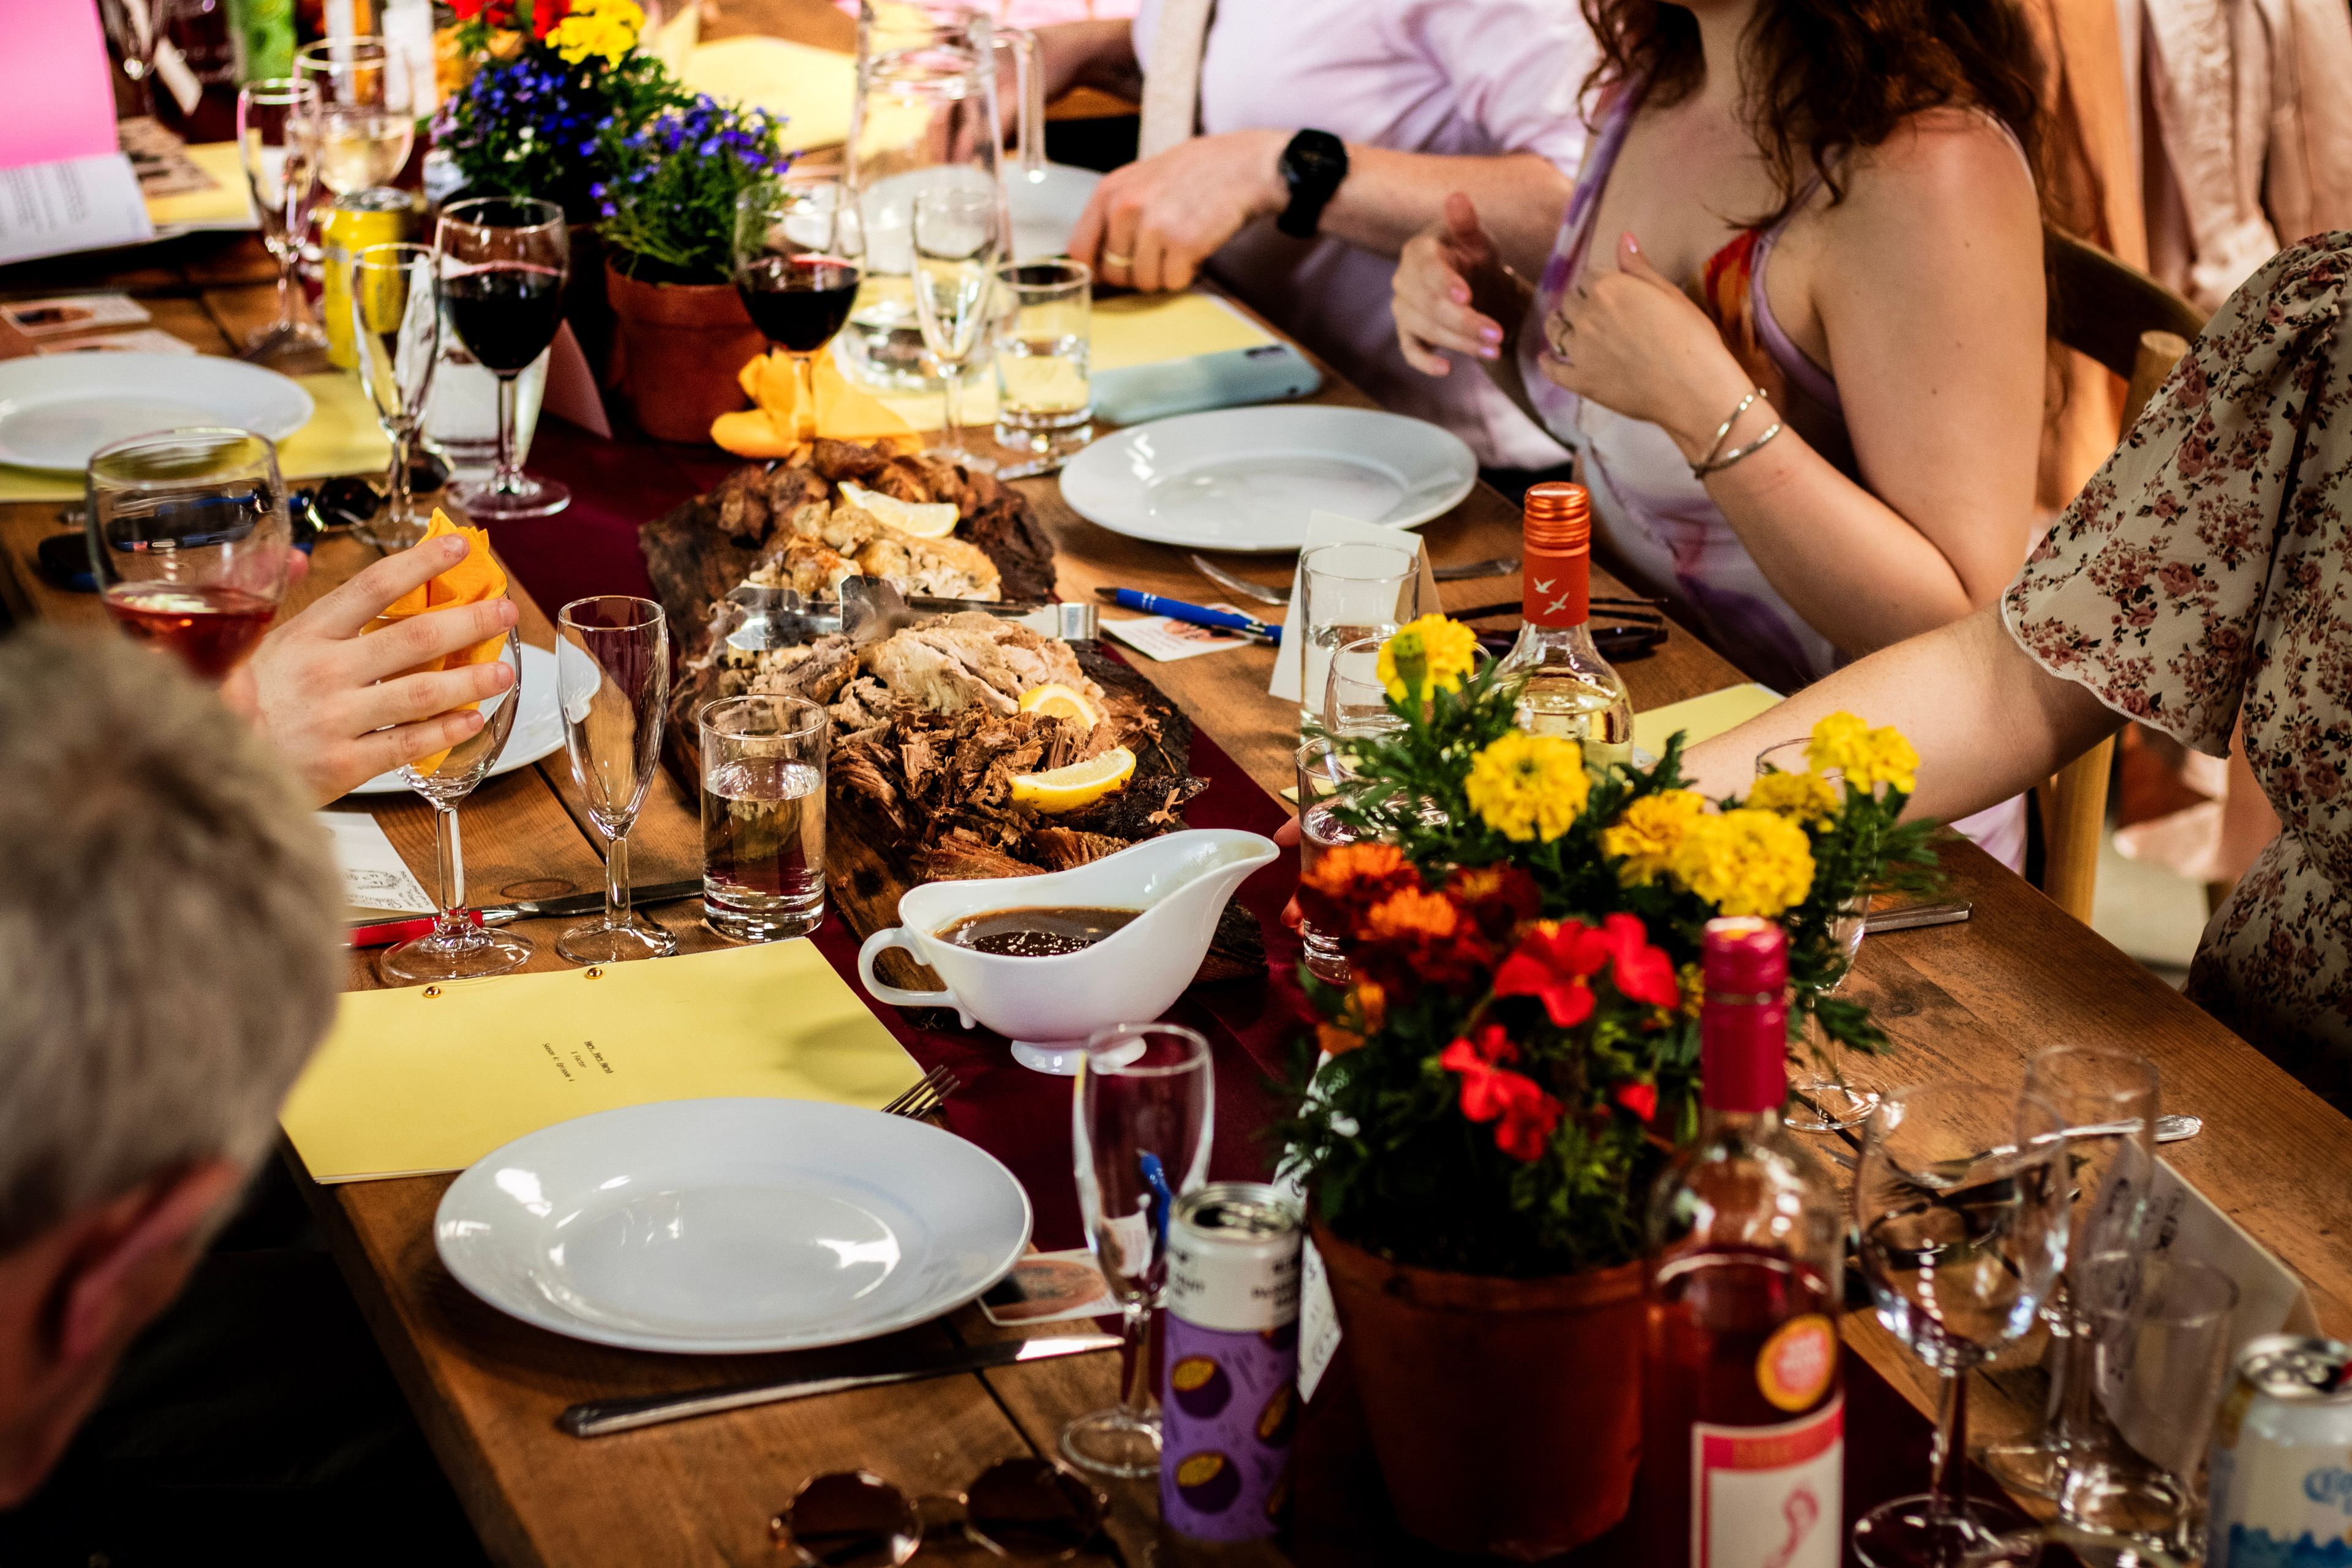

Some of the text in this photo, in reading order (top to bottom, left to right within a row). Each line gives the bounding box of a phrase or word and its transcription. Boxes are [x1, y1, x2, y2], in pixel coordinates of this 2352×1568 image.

[543, 1043, 555, 1055] Season
[556, 1063, 571, 1077] Episode
[573, 1055, 586, 1068] Factor
